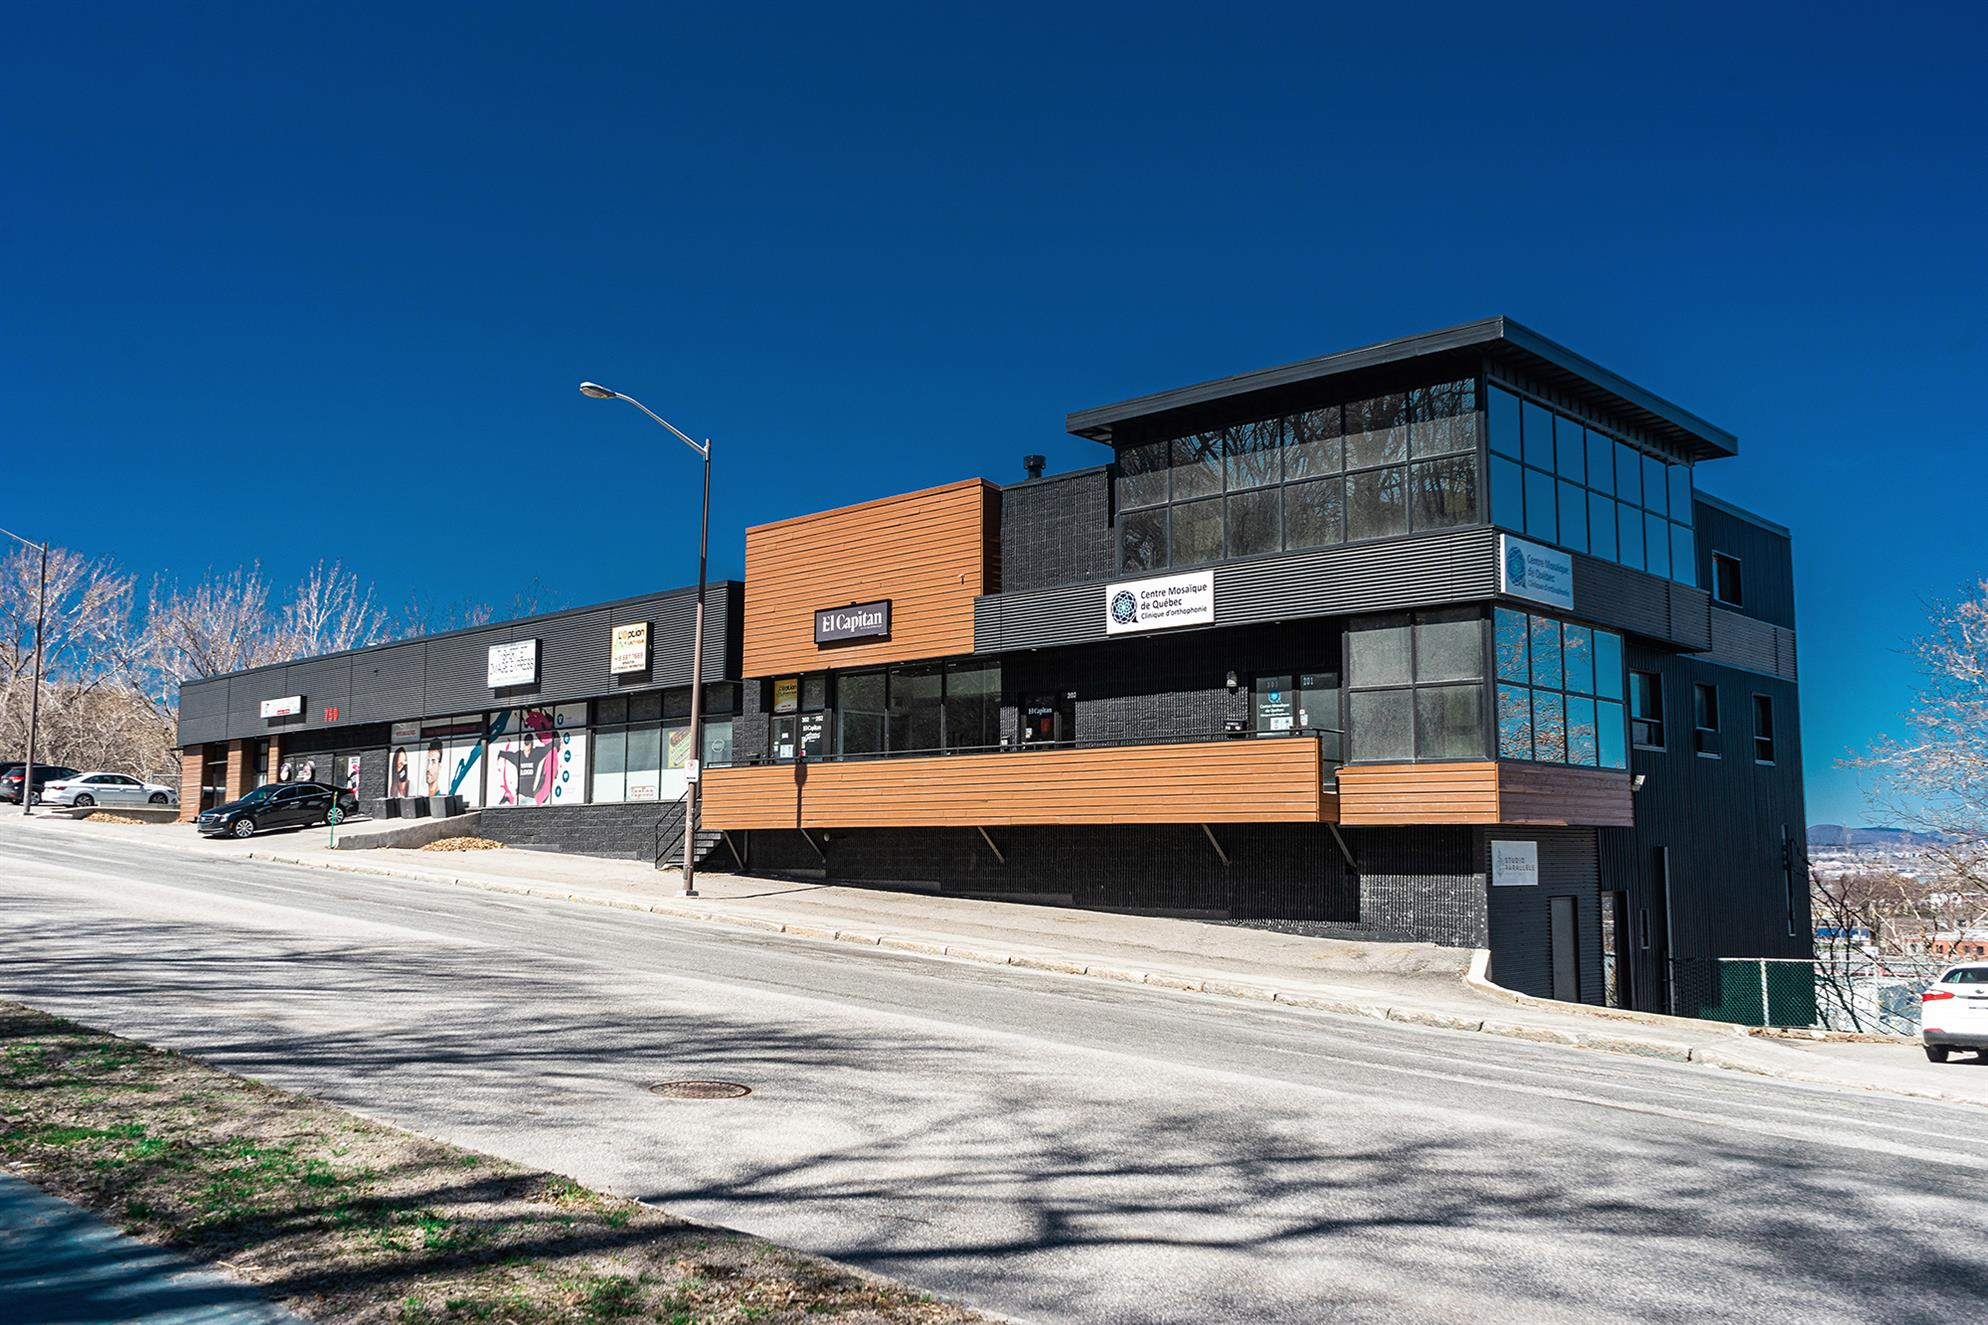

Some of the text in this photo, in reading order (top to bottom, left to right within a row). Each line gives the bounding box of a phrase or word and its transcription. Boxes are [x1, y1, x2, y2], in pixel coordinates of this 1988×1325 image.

[1141, 583, 1207, 599] Centre Mosaïque
[1141, 598, 1182, 610] de Québec
[1141, 605, 1207, 619] Clinique d'orthophonie
[822, 611, 882, 632] El Capitan
